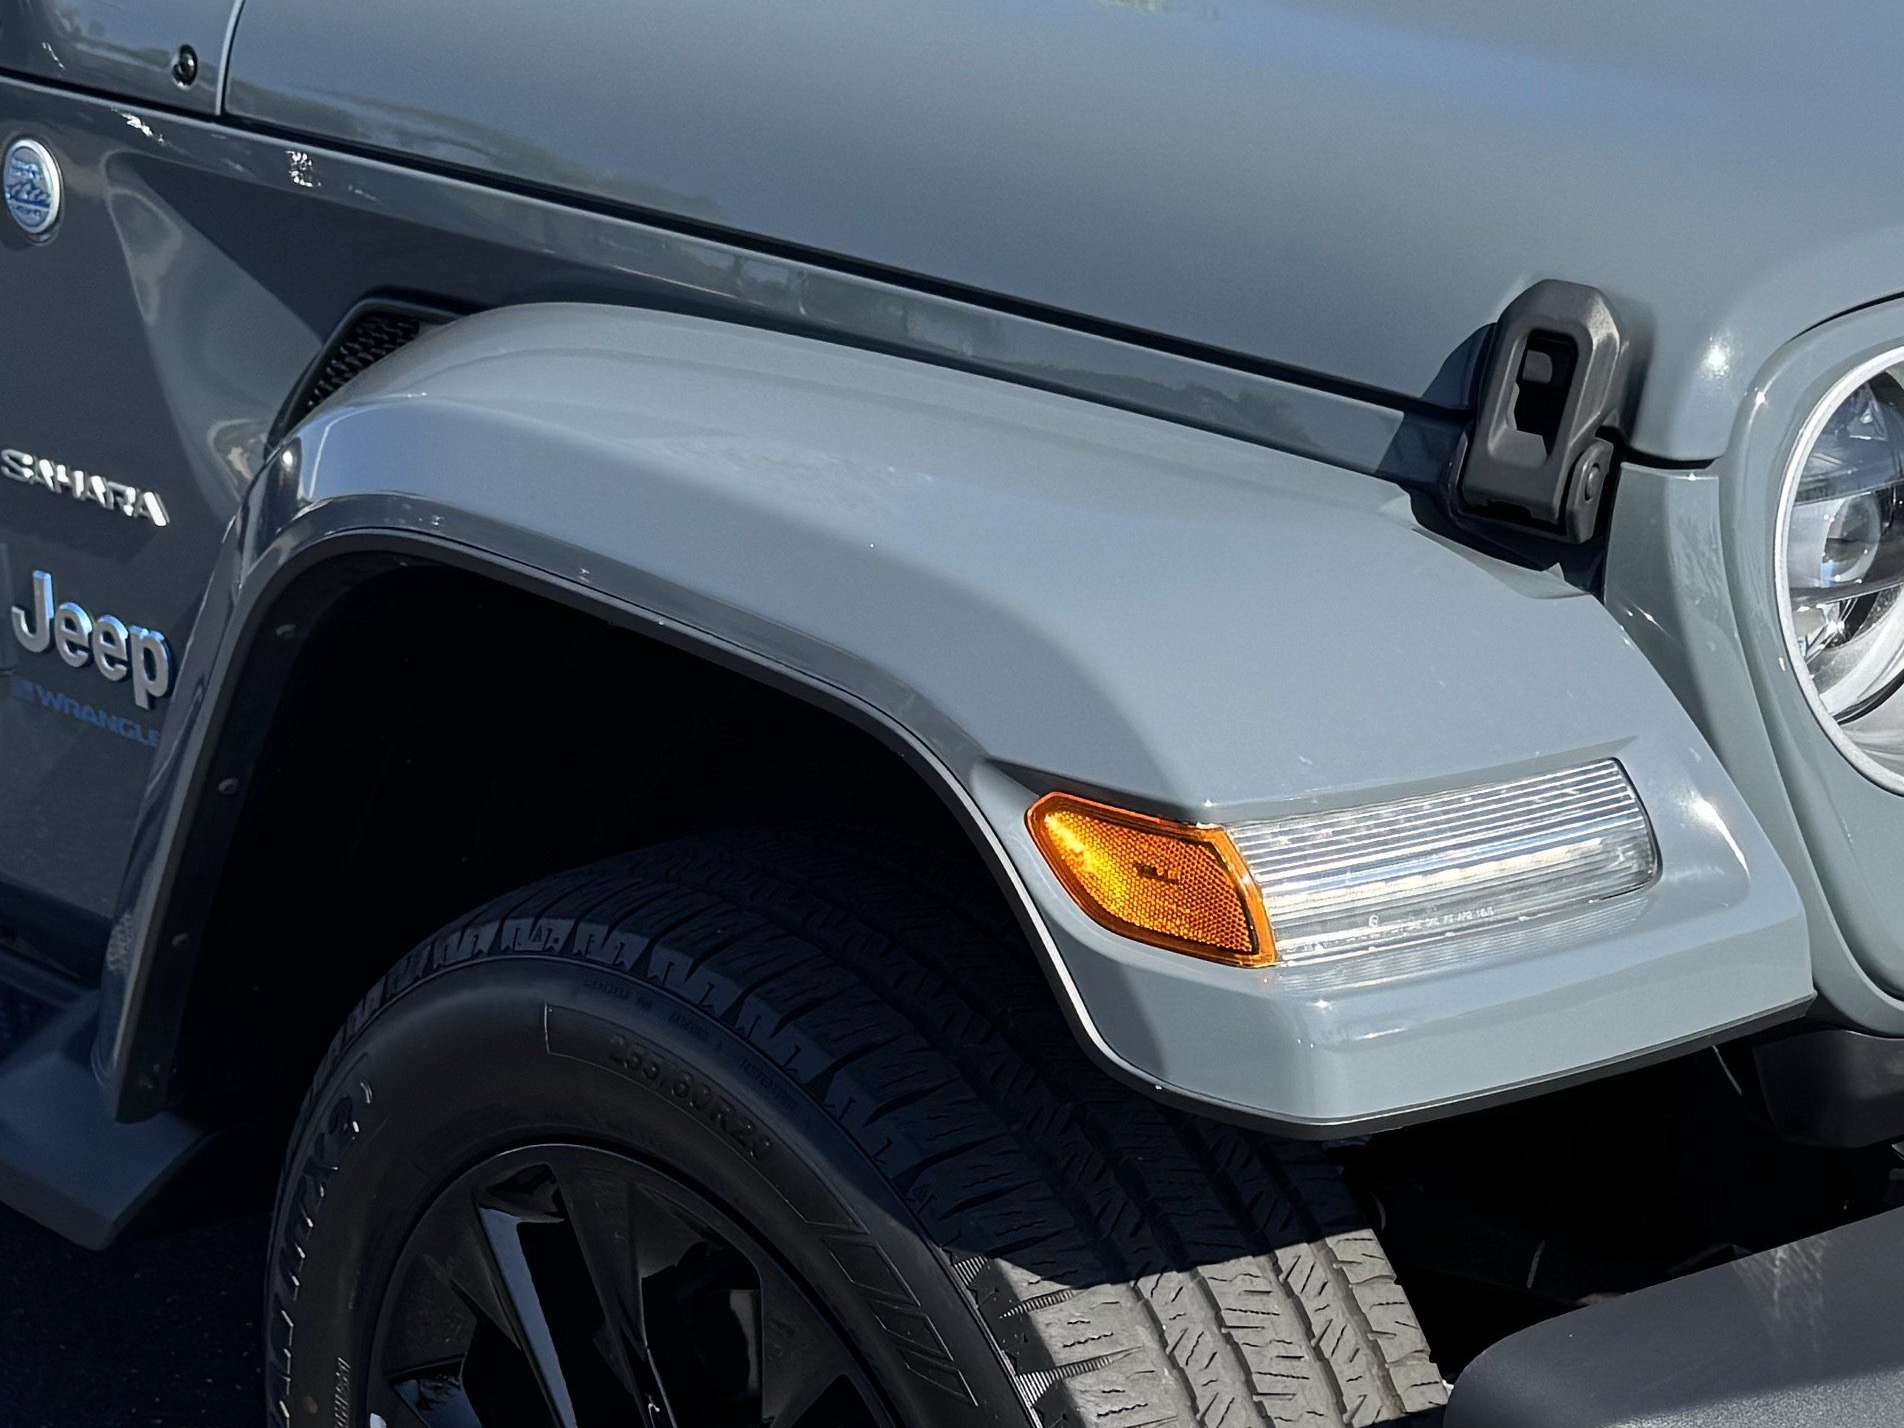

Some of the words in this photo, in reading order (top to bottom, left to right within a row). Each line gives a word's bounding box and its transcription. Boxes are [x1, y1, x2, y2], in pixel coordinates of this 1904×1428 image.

[0, 448, 171, 527] SAHARA
[10, 570, 173, 710] Jeep
[36, 685, 161, 749] WRANGLE
